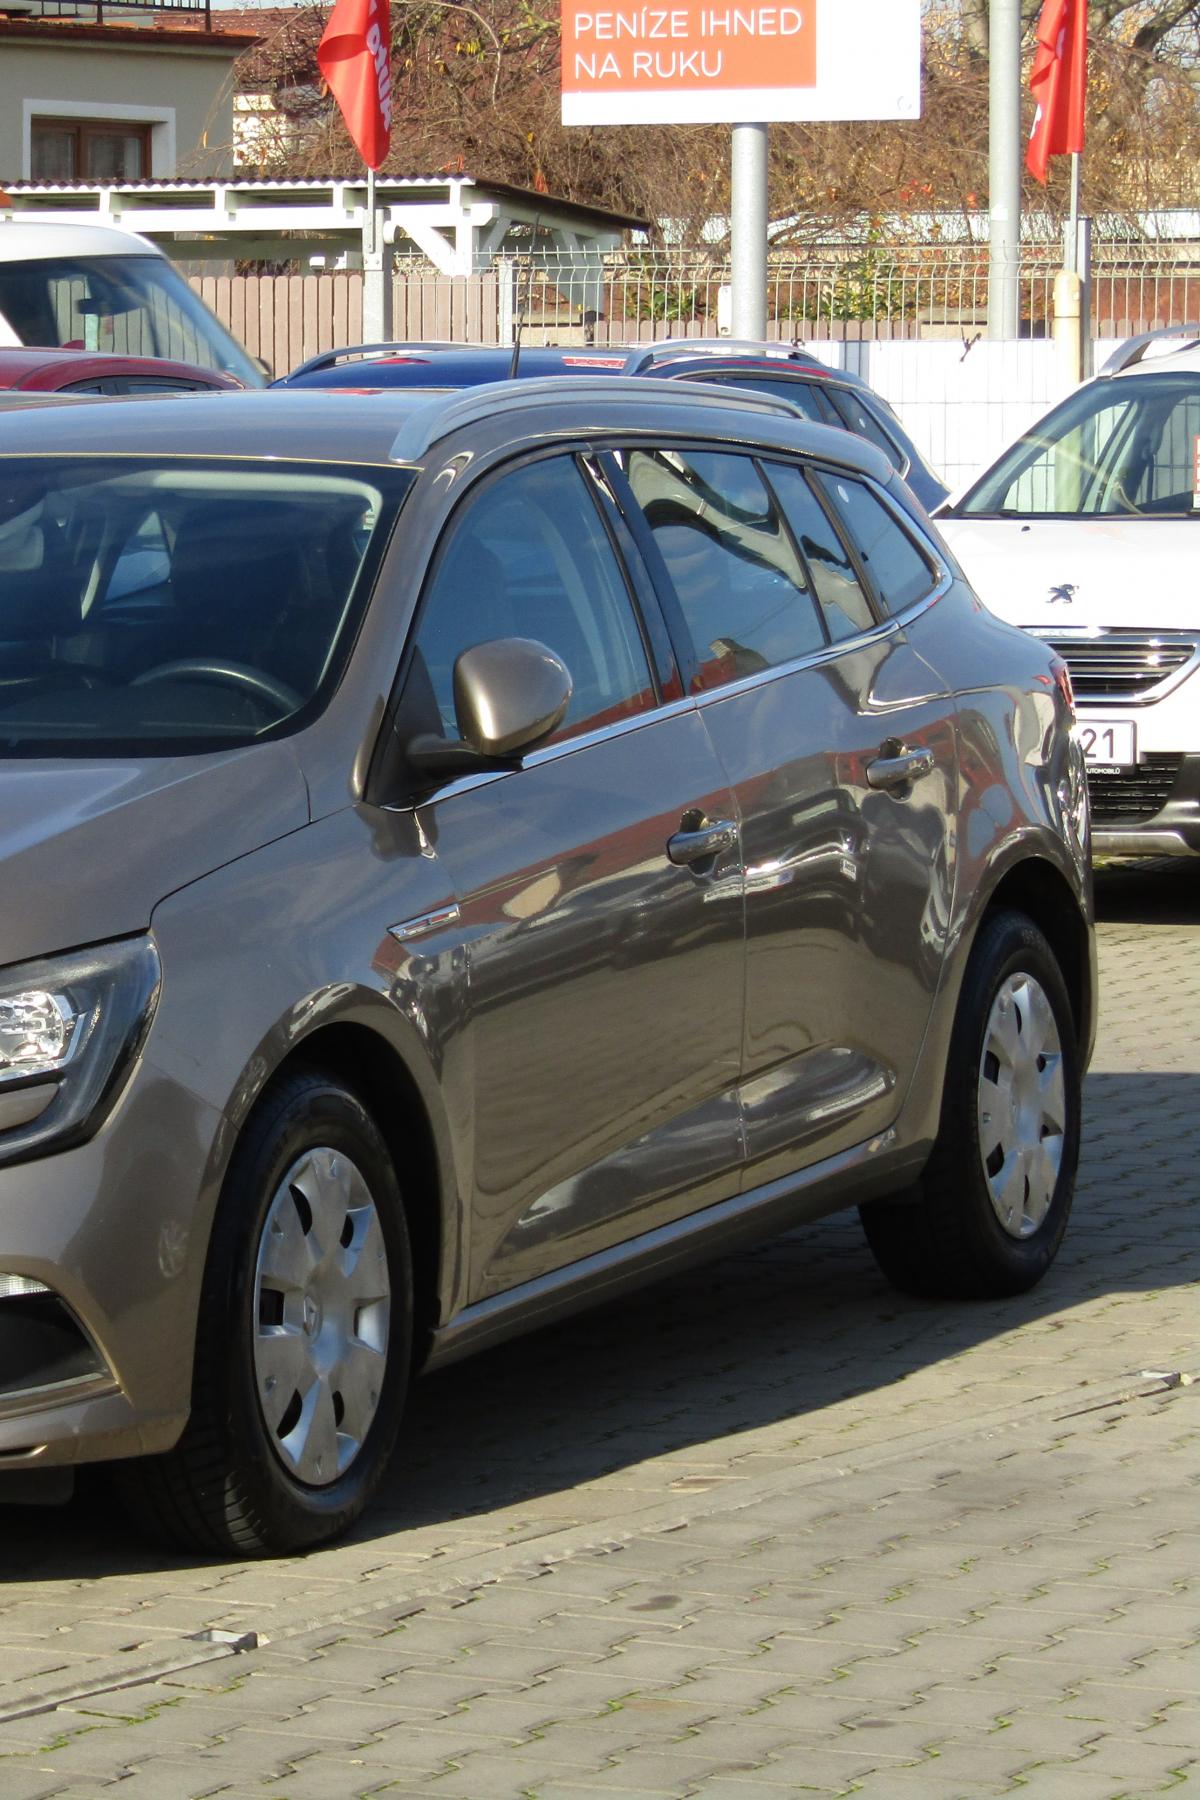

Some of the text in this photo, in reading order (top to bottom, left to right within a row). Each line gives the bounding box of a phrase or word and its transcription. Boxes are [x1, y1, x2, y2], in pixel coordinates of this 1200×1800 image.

[574, 6, 802, 40] PENÍZE IHNED
[575, 50, 722, 80] NA RUKU
